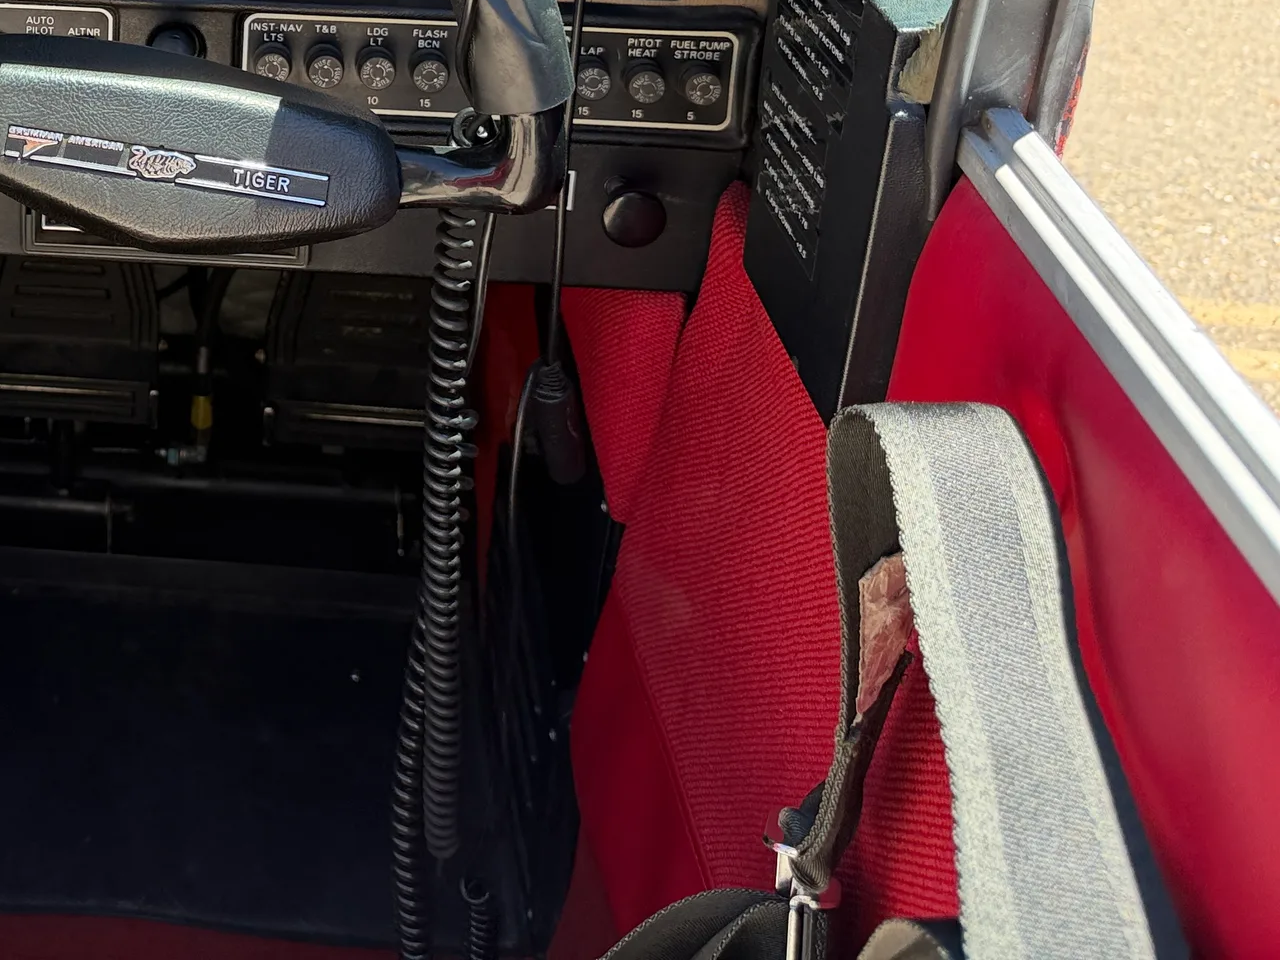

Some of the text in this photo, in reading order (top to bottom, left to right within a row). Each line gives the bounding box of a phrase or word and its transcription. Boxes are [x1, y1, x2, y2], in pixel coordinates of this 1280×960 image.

[26, 16, 54, 26] AUTO
[26, 26, 54, 36] PILOT
[68, 28, 101, 38] ALTNR
[250, 23, 303, 34] INST-NAV
[314, 25, 337, 35] T&B
[367, 28, 388, 38] LDG
[263, 32, 284, 42] LTS
[412, 29, 448, 39] FLASH
[369, 38, 382, 46] LT
[418, 39, 441, 49] BCN
[628, 38, 662, 49] PITOT
[670, 40, 730, 51] FUEL PUMP
[628, 48, 657, 58] HEAT
[674, 51, 720, 62] STROBE
[233, 168, 290, 193] TIGER
